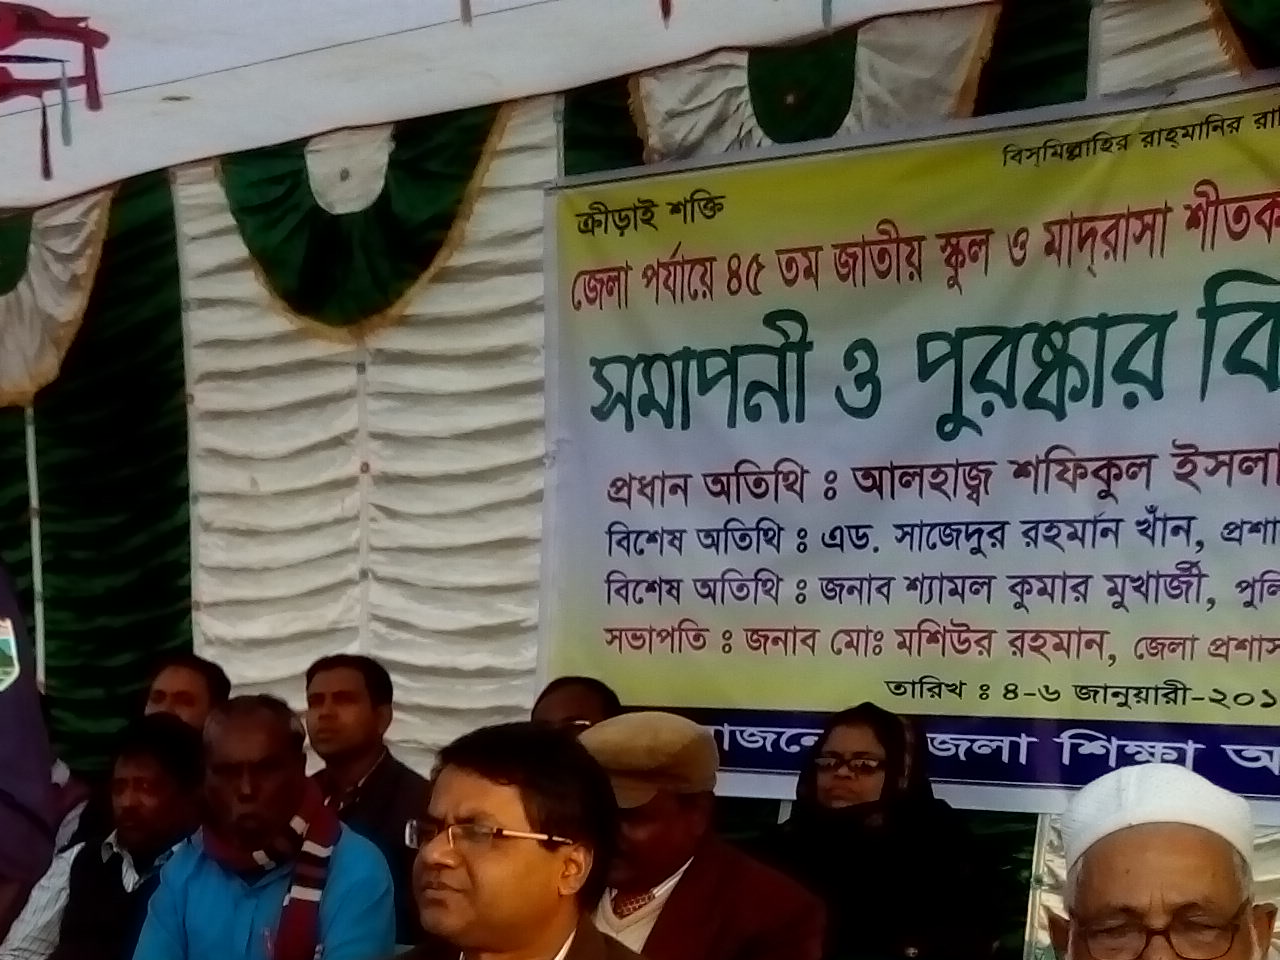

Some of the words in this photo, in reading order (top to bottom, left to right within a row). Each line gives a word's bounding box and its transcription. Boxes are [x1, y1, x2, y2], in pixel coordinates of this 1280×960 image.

[575, 198, 659, 236] ক্রীড়াই
[666, 188, 726, 224] শক্তি
[572, 260, 633, 311] জেলা
[642, 241, 717, 305] পর্যায়ে
[726, 253, 766, 296] ৪৫
[774, 246, 824, 291] তম
[831, 218, 928, 288] জাতীয়
[934, 228, 995, 295] স্কুল
[1007, 226, 1030, 267] ও
[589, 309, 814, 432] সমাপনী
[834, 338, 882, 419] ও
[607, 471, 692, 510] প্রধান
[701, 457, 809, 504] অতিথি
[850, 458, 997, 507] আলহাজ্ব
[1007, 444, 1159, 504] শফিকুল
[605, 521, 687, 556] বিশেষ
[696, 516, 784, 556] অতিথি
[821, 524, 880, 553] এড.
[892, 518, 1010, 558] সাজেদুর
[604, 570, 684, 605] বিশেষ
[691, 567, 783, 606] অতিথি
[818, 573, 896, 605] জনাব
[904, 572, 997, 605] শ্যামল
[1005, 570, 1094, 614] কুমার
[603, 618, 710, 654] সভাপতি
[742, 625, 821, 655] জনাব
[893, 618, 997, 658] মশিউর
[1006, 626, 1117, 667] রহমান,
[1133, 634, 1200, 661] জেলা
[885, 675, 967, 700] তারিখ
